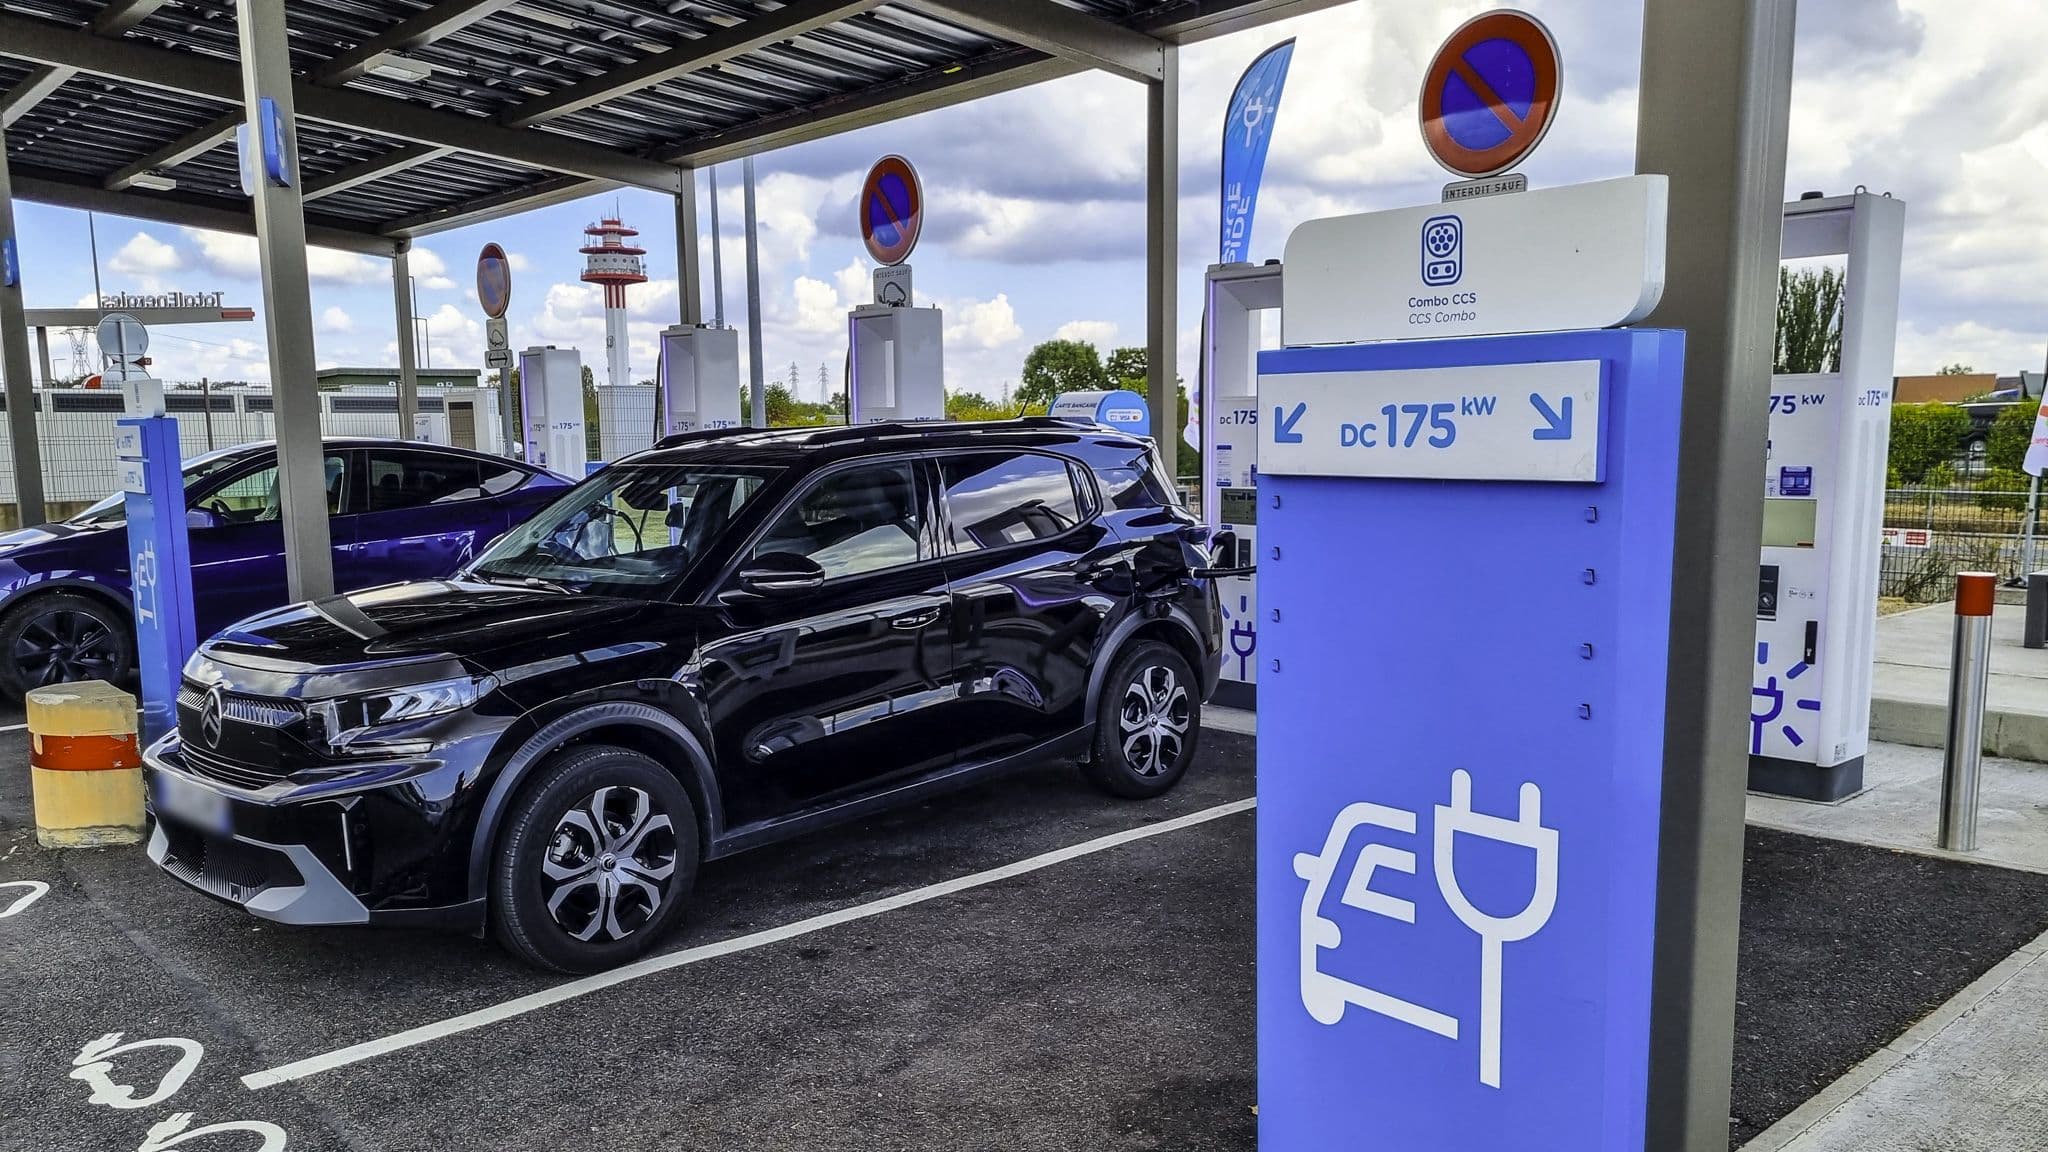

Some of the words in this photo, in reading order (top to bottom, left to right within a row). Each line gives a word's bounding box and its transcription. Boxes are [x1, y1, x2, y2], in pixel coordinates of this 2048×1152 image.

[1445, 185, 1490, 199] INTERDIT
[1494, 180, 1521, 192] SAUF
[1408, 296, 1449, 308] Combo
[1452, 292, 1476, 305] CCS
[1408, 312, 1432, 324] CCS
[1434, 310, 1476, 323] Combo
[1769, 395, 1796, 414] 75
[1801, 394, 1825, 405] kW
[1867, 390, 1880, 406] 175
[712, 420, 728, 429] 175
[1220, 416, 1231, 425] DC
[1233, 410, 1257, 425] 175
[1341, 423, 1377, 448] DC
[1381, 403, 1456, 448] 175
[1461, 396, 1497, 416] kW
[560, 422, 572, 430] 175
[678, 421, 689, 431] 175
